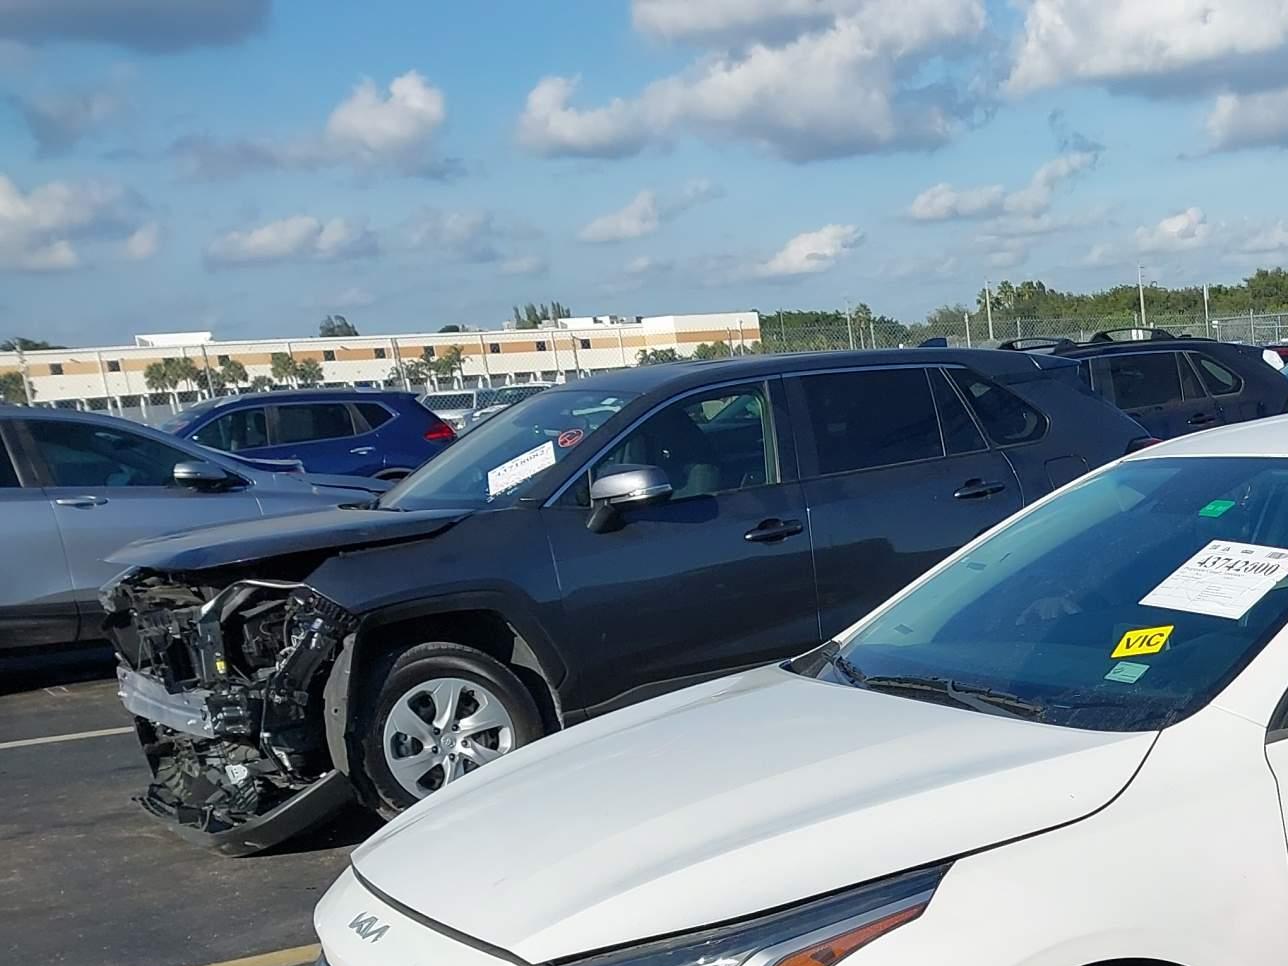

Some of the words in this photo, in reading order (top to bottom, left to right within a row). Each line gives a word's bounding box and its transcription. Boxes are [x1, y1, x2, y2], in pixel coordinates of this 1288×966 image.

[1197, 554, 1281, 577] 43742000
[1125, 632, 1165, 650] VIC
[348, 911, 391, 944] KIA
